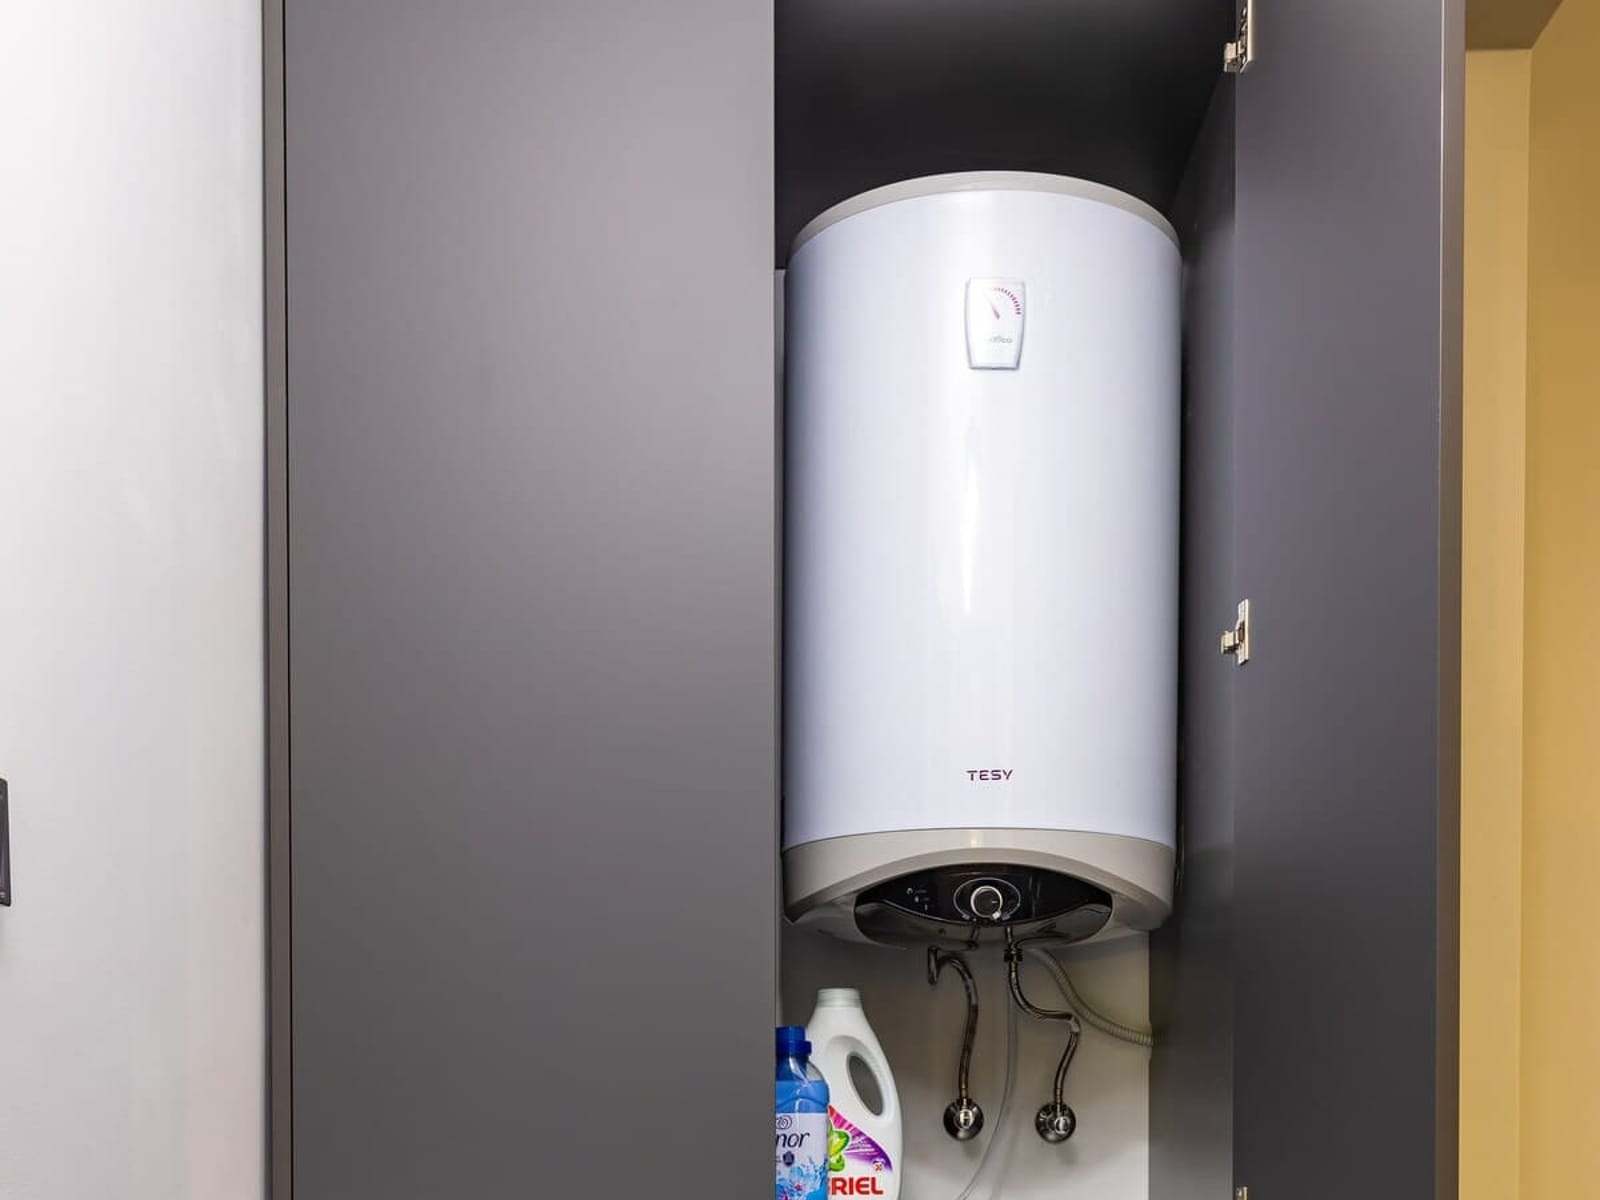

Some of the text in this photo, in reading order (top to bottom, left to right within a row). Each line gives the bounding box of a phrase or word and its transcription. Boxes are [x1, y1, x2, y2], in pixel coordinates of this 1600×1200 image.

[966, 769, 1013, 781] TESY
[775, 1132, 810, 1148] nor
[828, 1176, 884, 1195] RIEL
